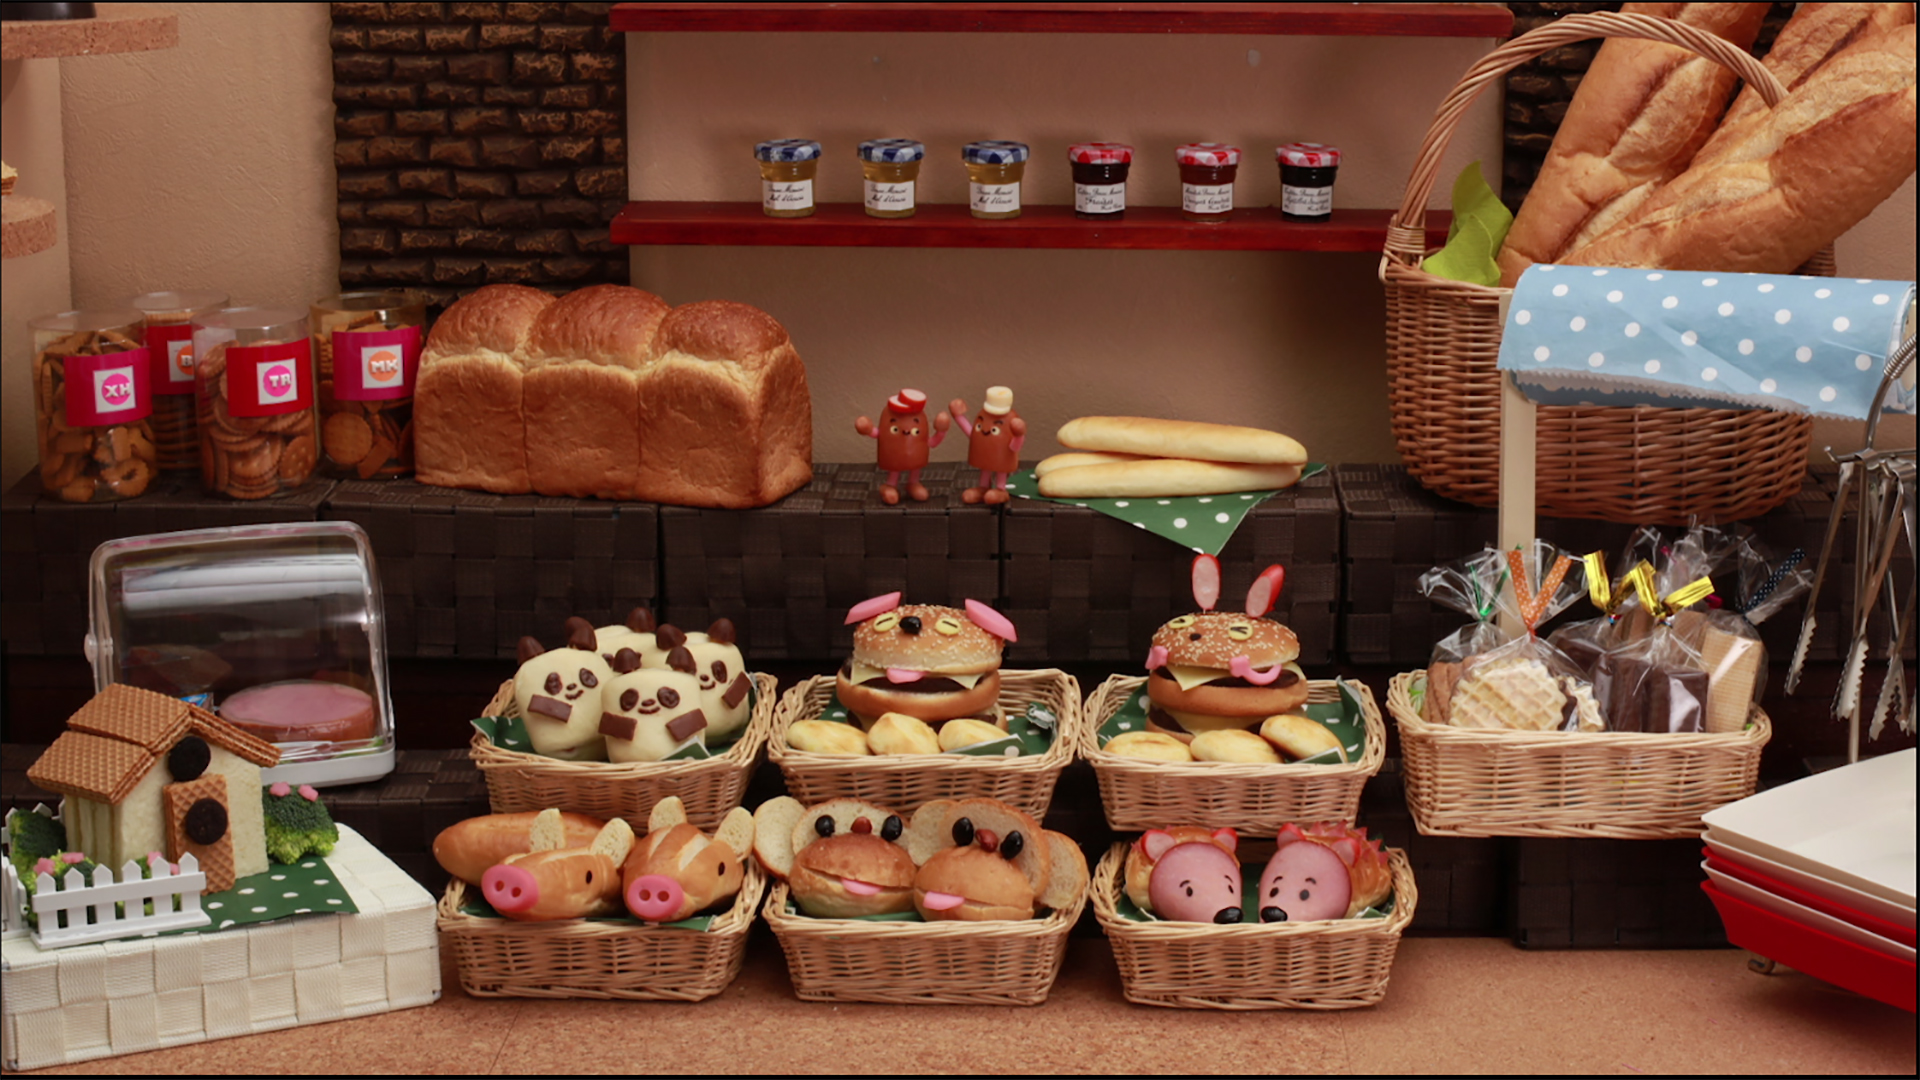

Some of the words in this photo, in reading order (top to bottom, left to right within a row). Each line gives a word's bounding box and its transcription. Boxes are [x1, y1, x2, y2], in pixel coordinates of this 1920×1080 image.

[370, 359, 398, 373] MK
[269, 373, 291, 387] TR
[104, 383, 131, 398] XH
